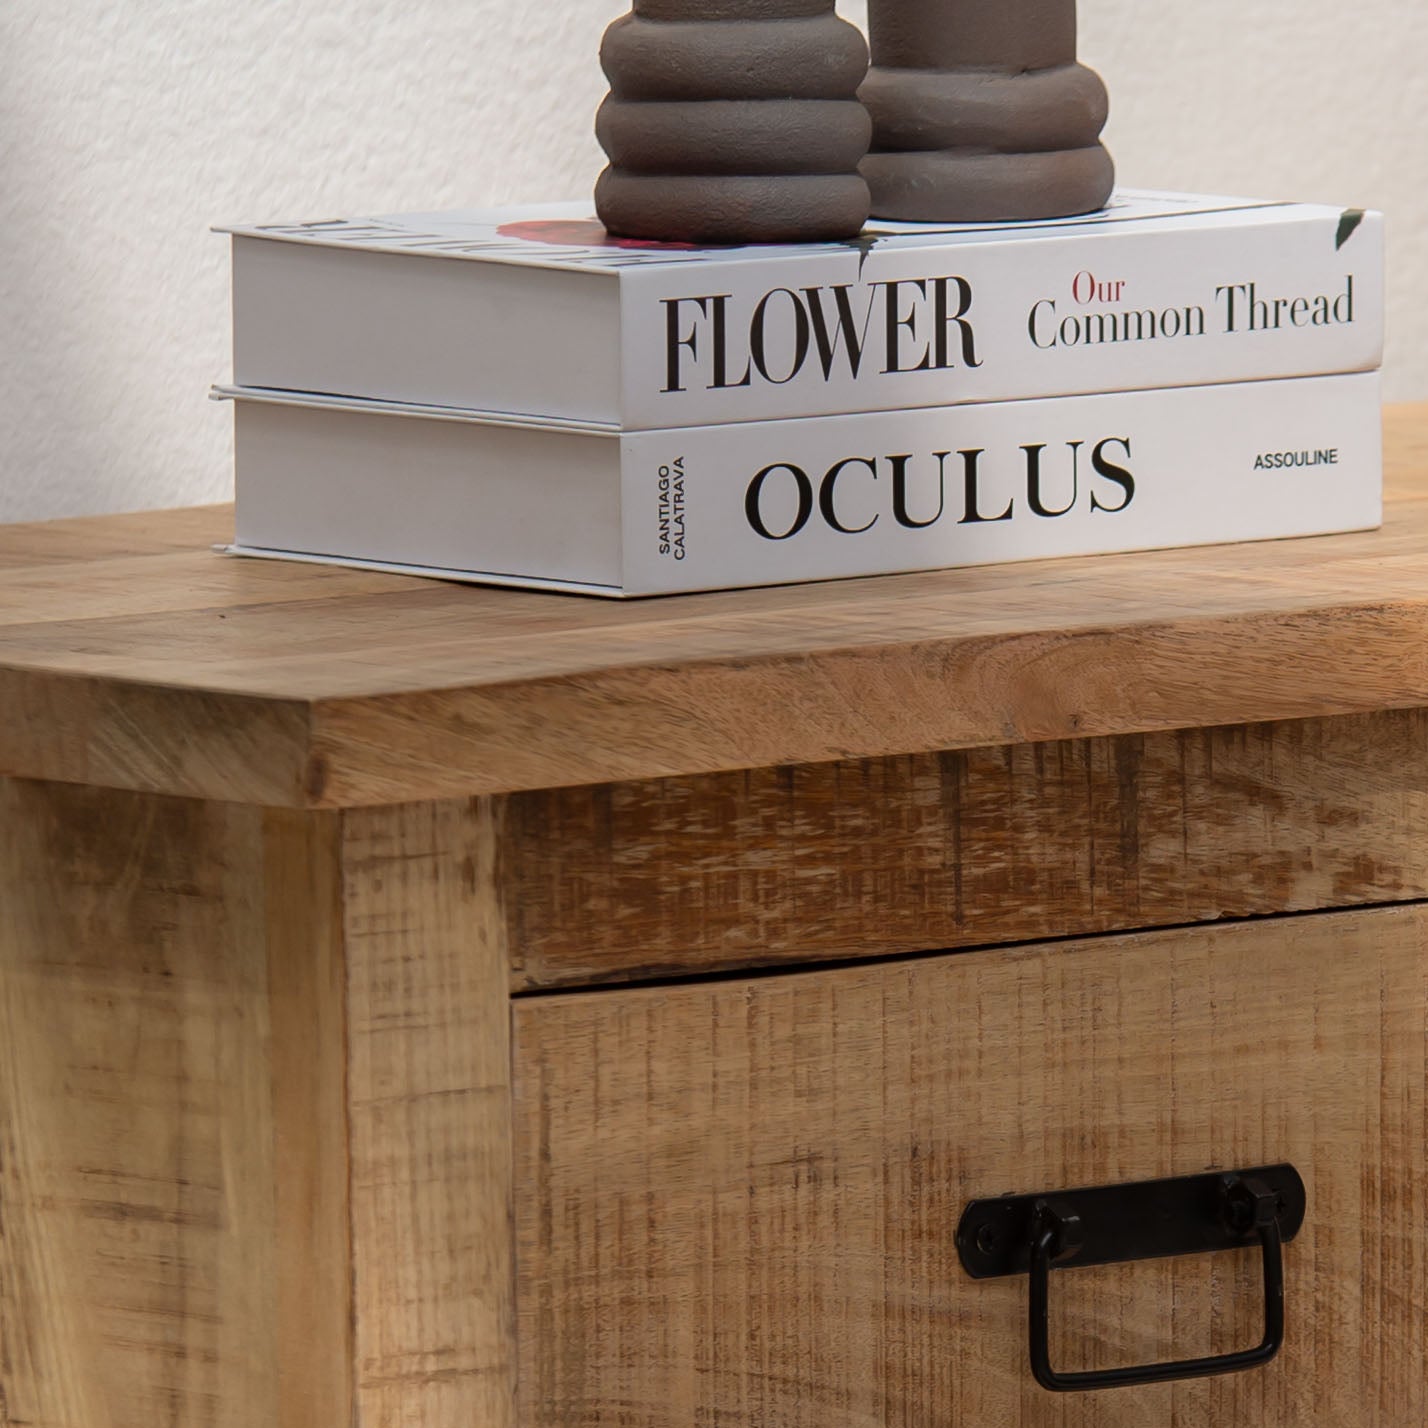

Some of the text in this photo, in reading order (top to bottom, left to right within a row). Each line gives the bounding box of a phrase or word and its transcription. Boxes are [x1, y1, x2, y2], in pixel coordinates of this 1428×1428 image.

[1027, 274, 1355, 349] Common Thread
[1072, 270, 1126, 304] Our
[659, 275, 984, 393] FLOWER
[744, 436, 1136, 541] OCULUS
[1253, 448, 1339, 470] ASSOULINE
[658, 465, 671, 555] SANTIAGO
[672, 456, 686, 561] CALATRAVA
